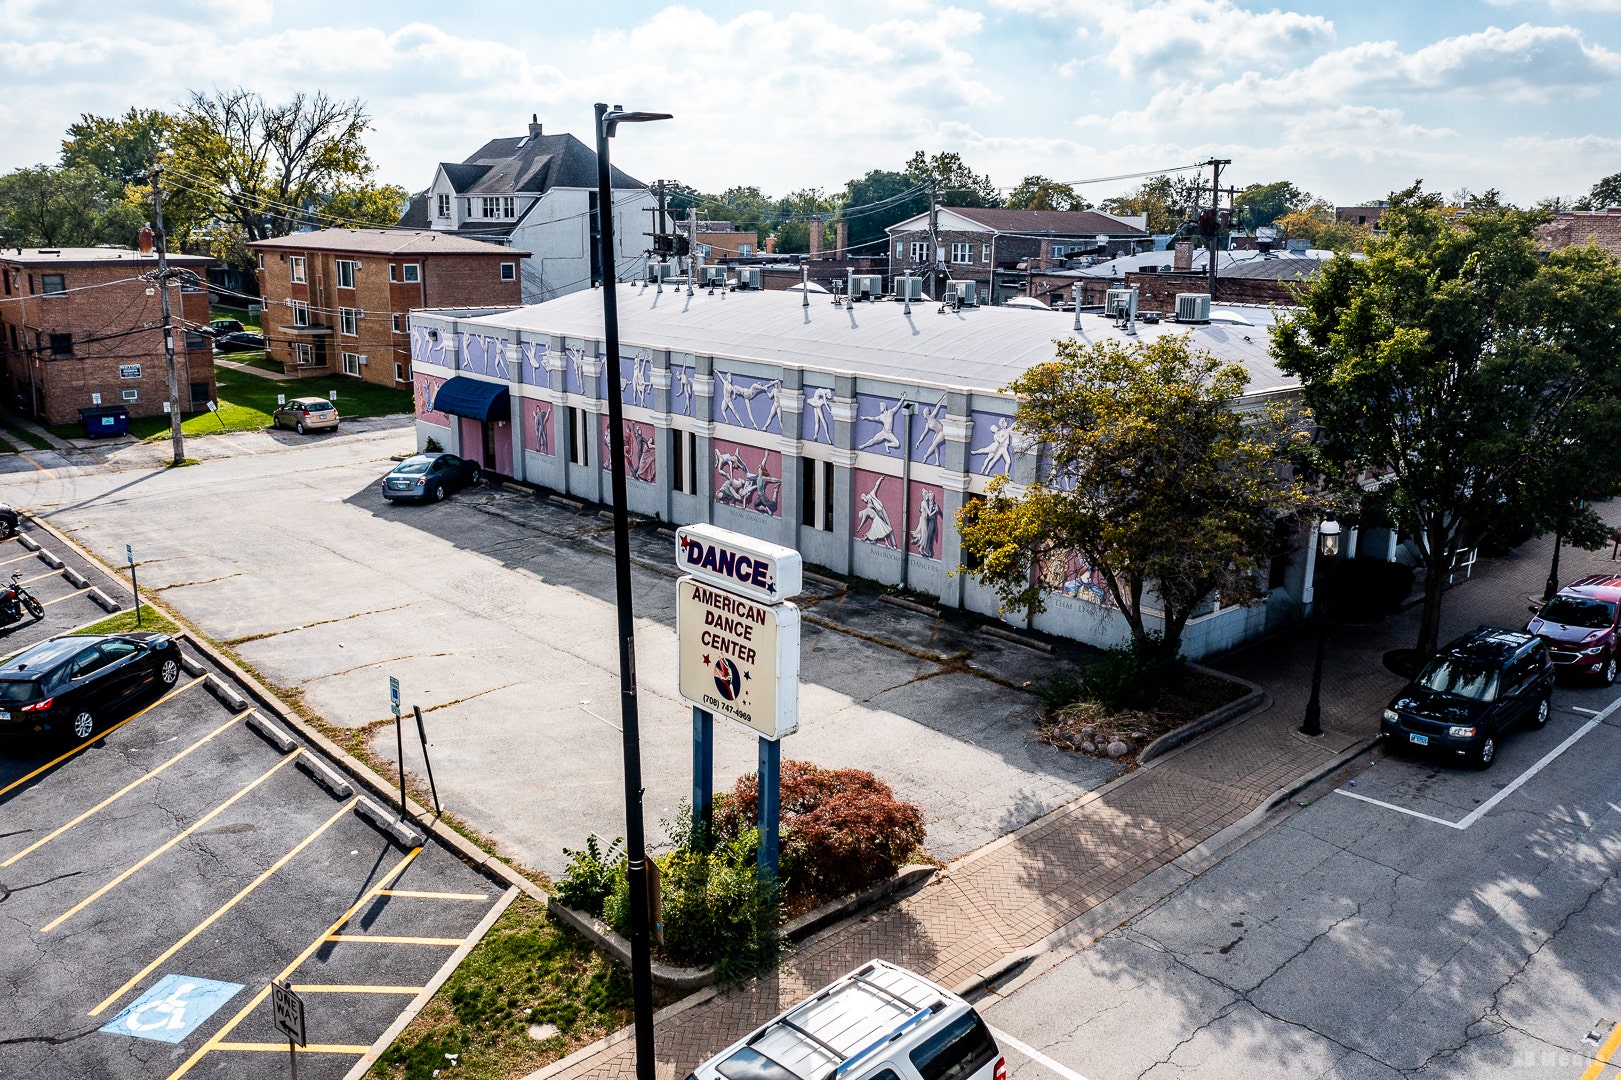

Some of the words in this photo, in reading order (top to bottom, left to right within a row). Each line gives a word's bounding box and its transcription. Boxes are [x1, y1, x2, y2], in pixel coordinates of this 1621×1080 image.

[687, 539, 768, 588] DANCE
[910, 559, 938, 572] DANCERS
[692, 586, 766, 625] AMERICAN
[1055, 600, 1073, 610] THAI
[705, 610, 753, 641] DANCE
[701, 630, 756, 665] CENTER
[703, 694, 720, 708] (708)
[721, 702, 751, 722] 747-4969
[276, 990, 297, 1013] ONE
[276, 1001, 298, 1025] WAY
